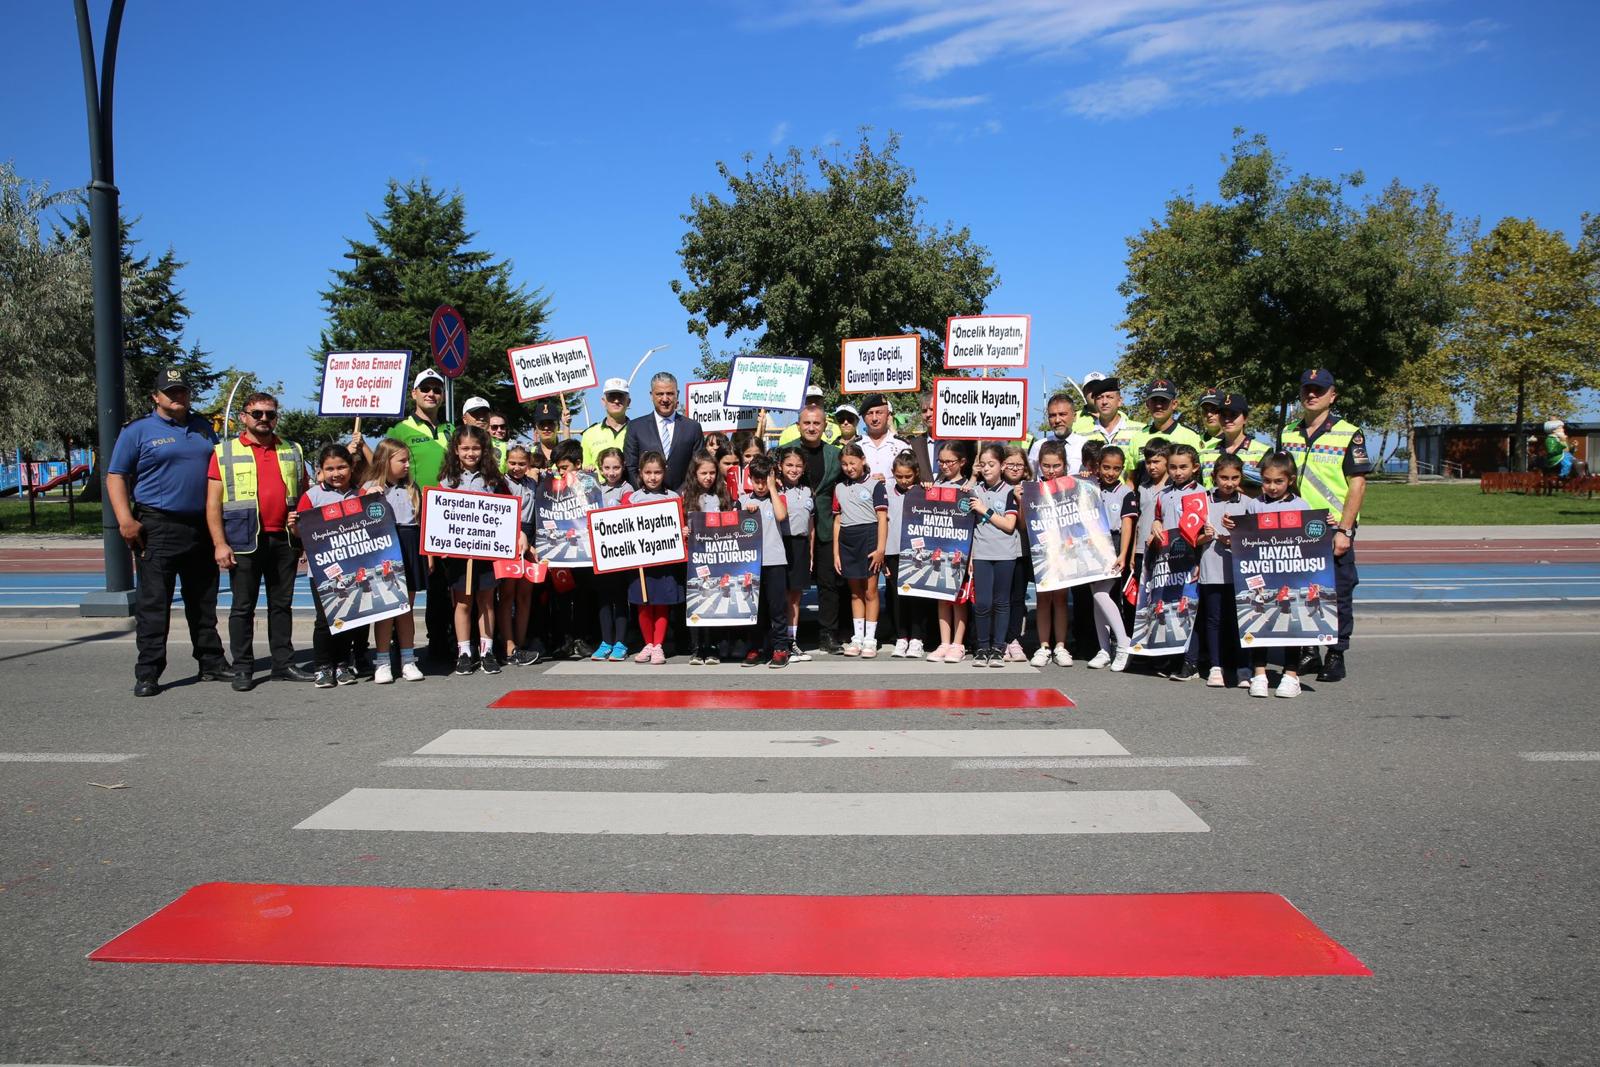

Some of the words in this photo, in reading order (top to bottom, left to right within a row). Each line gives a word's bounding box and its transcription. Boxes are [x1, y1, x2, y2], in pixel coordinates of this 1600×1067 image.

[988, 325, 1023, 340] Hayatın,
[552, 349, 587, 365] Hayatın,
[858, 348, 875, 365] Yaya
[877, 346, 903, 364] Geçidi,
[953, 343, 984, 357] Öncelik
[329, 358, 350, 370] Canın
[351, 358, 370, 370] Sana
[372, 357, 402, 370] Emanet
[737, 361, 749, 375] Yaya
[335, 377, 354, 392] Yaya
[356, 376, 393, 392] Geçidini
[522, 373, 554, 389] Öncelik
[757, 376, 778, 388] Güvenle
[847, 368, 885, 386] Güvenliğin
[886, 367, 914, 384] Belgesi
[342, 395, 368, 408] Tercih
[370, 395, 380, 408] Et
[981, 390, 1020, 408] Hayatın,
[693, 408, 722, 423] Öncelik
[942, 408, 977, 426] Öncelik
[435, 495, 475, 510] Karşıdan
[478, 500, 511, 514] Karşıya
[552, 497, 580, 512] HAYATA
[1043, 502, 1078, 518] HAYATA
[443, 510, 480, 523] Güvenle
[482, 513, 503, 527] Geç.
[539, 507, 564, 520] SAYGI
[923, 514, 953, 527] HAYATA
[449, 524, 465, 535] Her
[467, 527, 496, 538] zaman
[637, 514, 677, 533] Hayatın,
[329, 528, 370, 549] HAYATA
[908, 524, 932, 537] SAYGI
[933, 527, 969, 541] DURUŞU
[314, 545, 348, 566] SAYGI
[348, 534, 393, 558] DURUŞU
[430, 535, 452, 549] Yaya
[454, 538, 491, 552] Geçidini
[493, 541, 513, 555] Seç.
[601, 541, 637, 559] Öncelik
[705, 539, 739, 553] HAYATA
[1259, 545, 1302, 560] HAYATA
[692, 552, 717, 564] SAYGI
[718, 550, 757, 564] DURUŞU
[1240, 560, 1273, 574] SAYGI
[1275, 557, 1326, 573] DURUŞU
